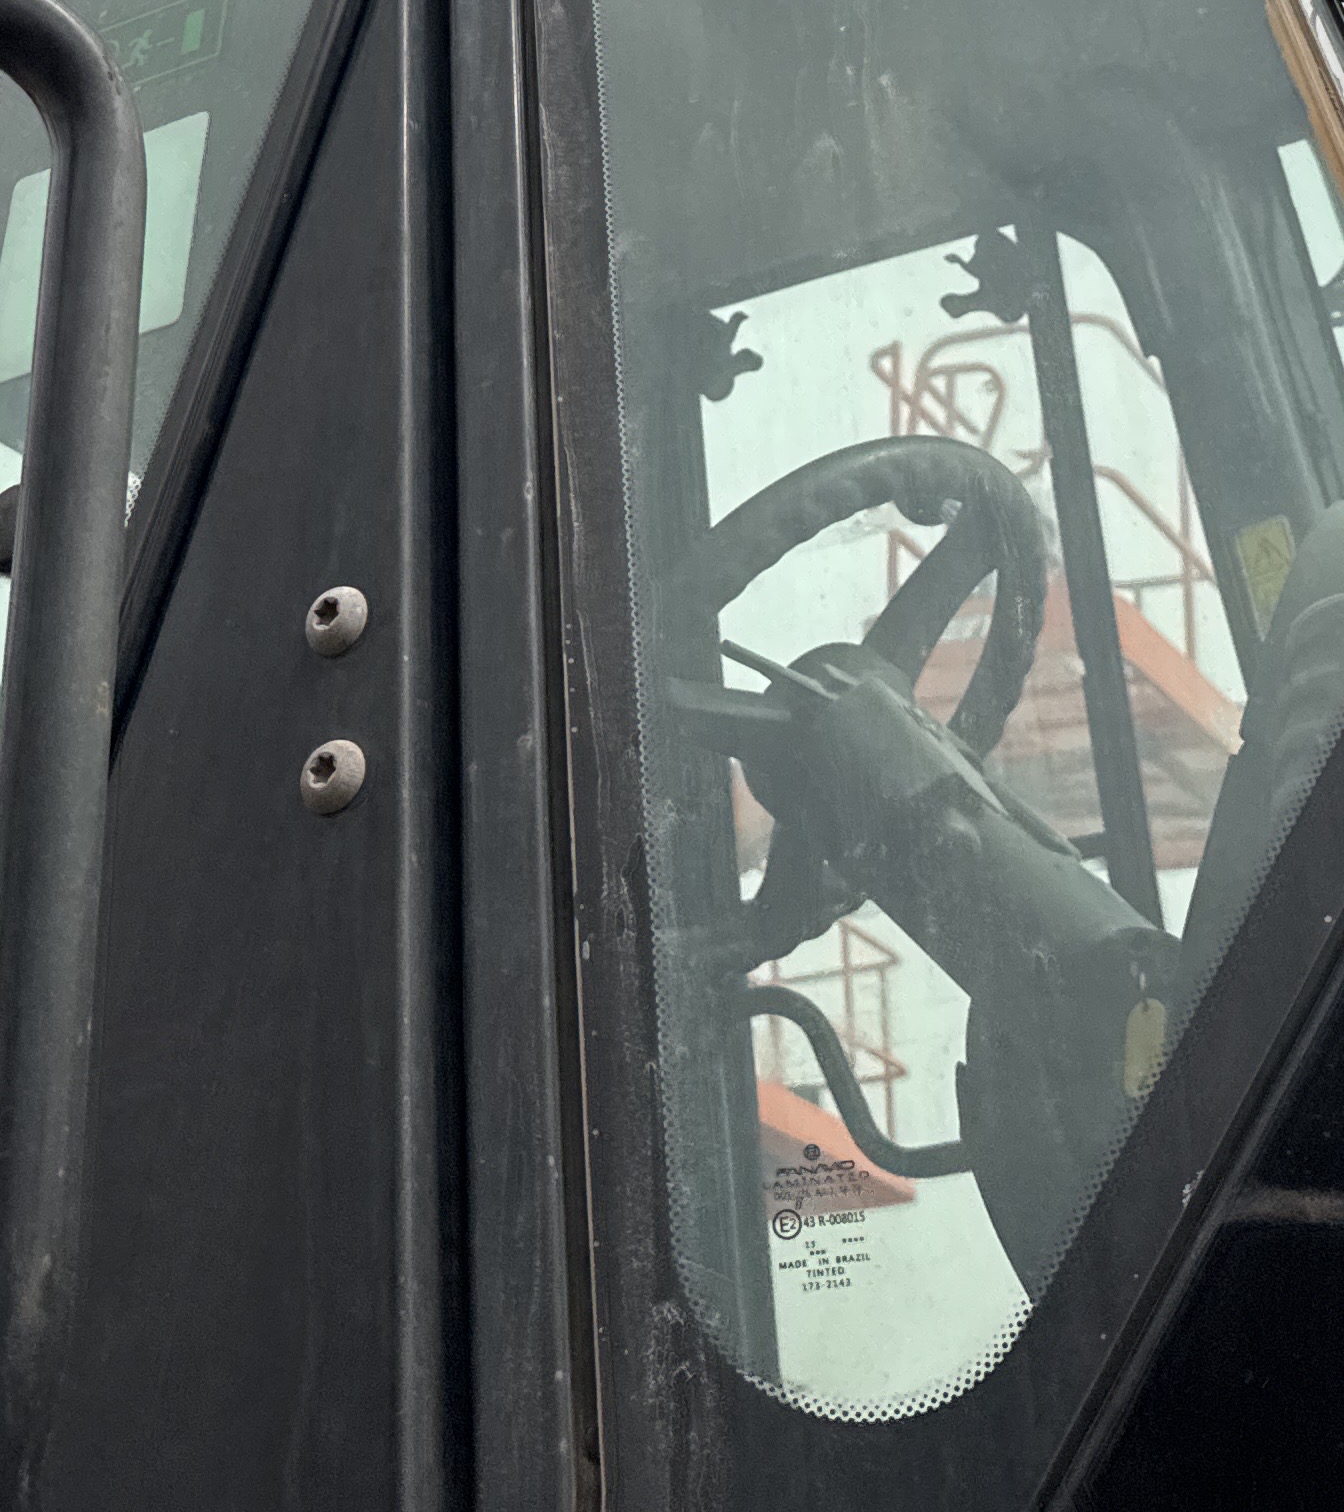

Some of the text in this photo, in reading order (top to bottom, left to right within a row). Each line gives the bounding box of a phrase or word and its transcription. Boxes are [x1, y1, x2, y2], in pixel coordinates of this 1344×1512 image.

[803, 1215, 816, 1227] 43
[778, 1253, 871, 1270] MADE IN BRAZIL
[806, 1266, 845, 1277] TINTED
